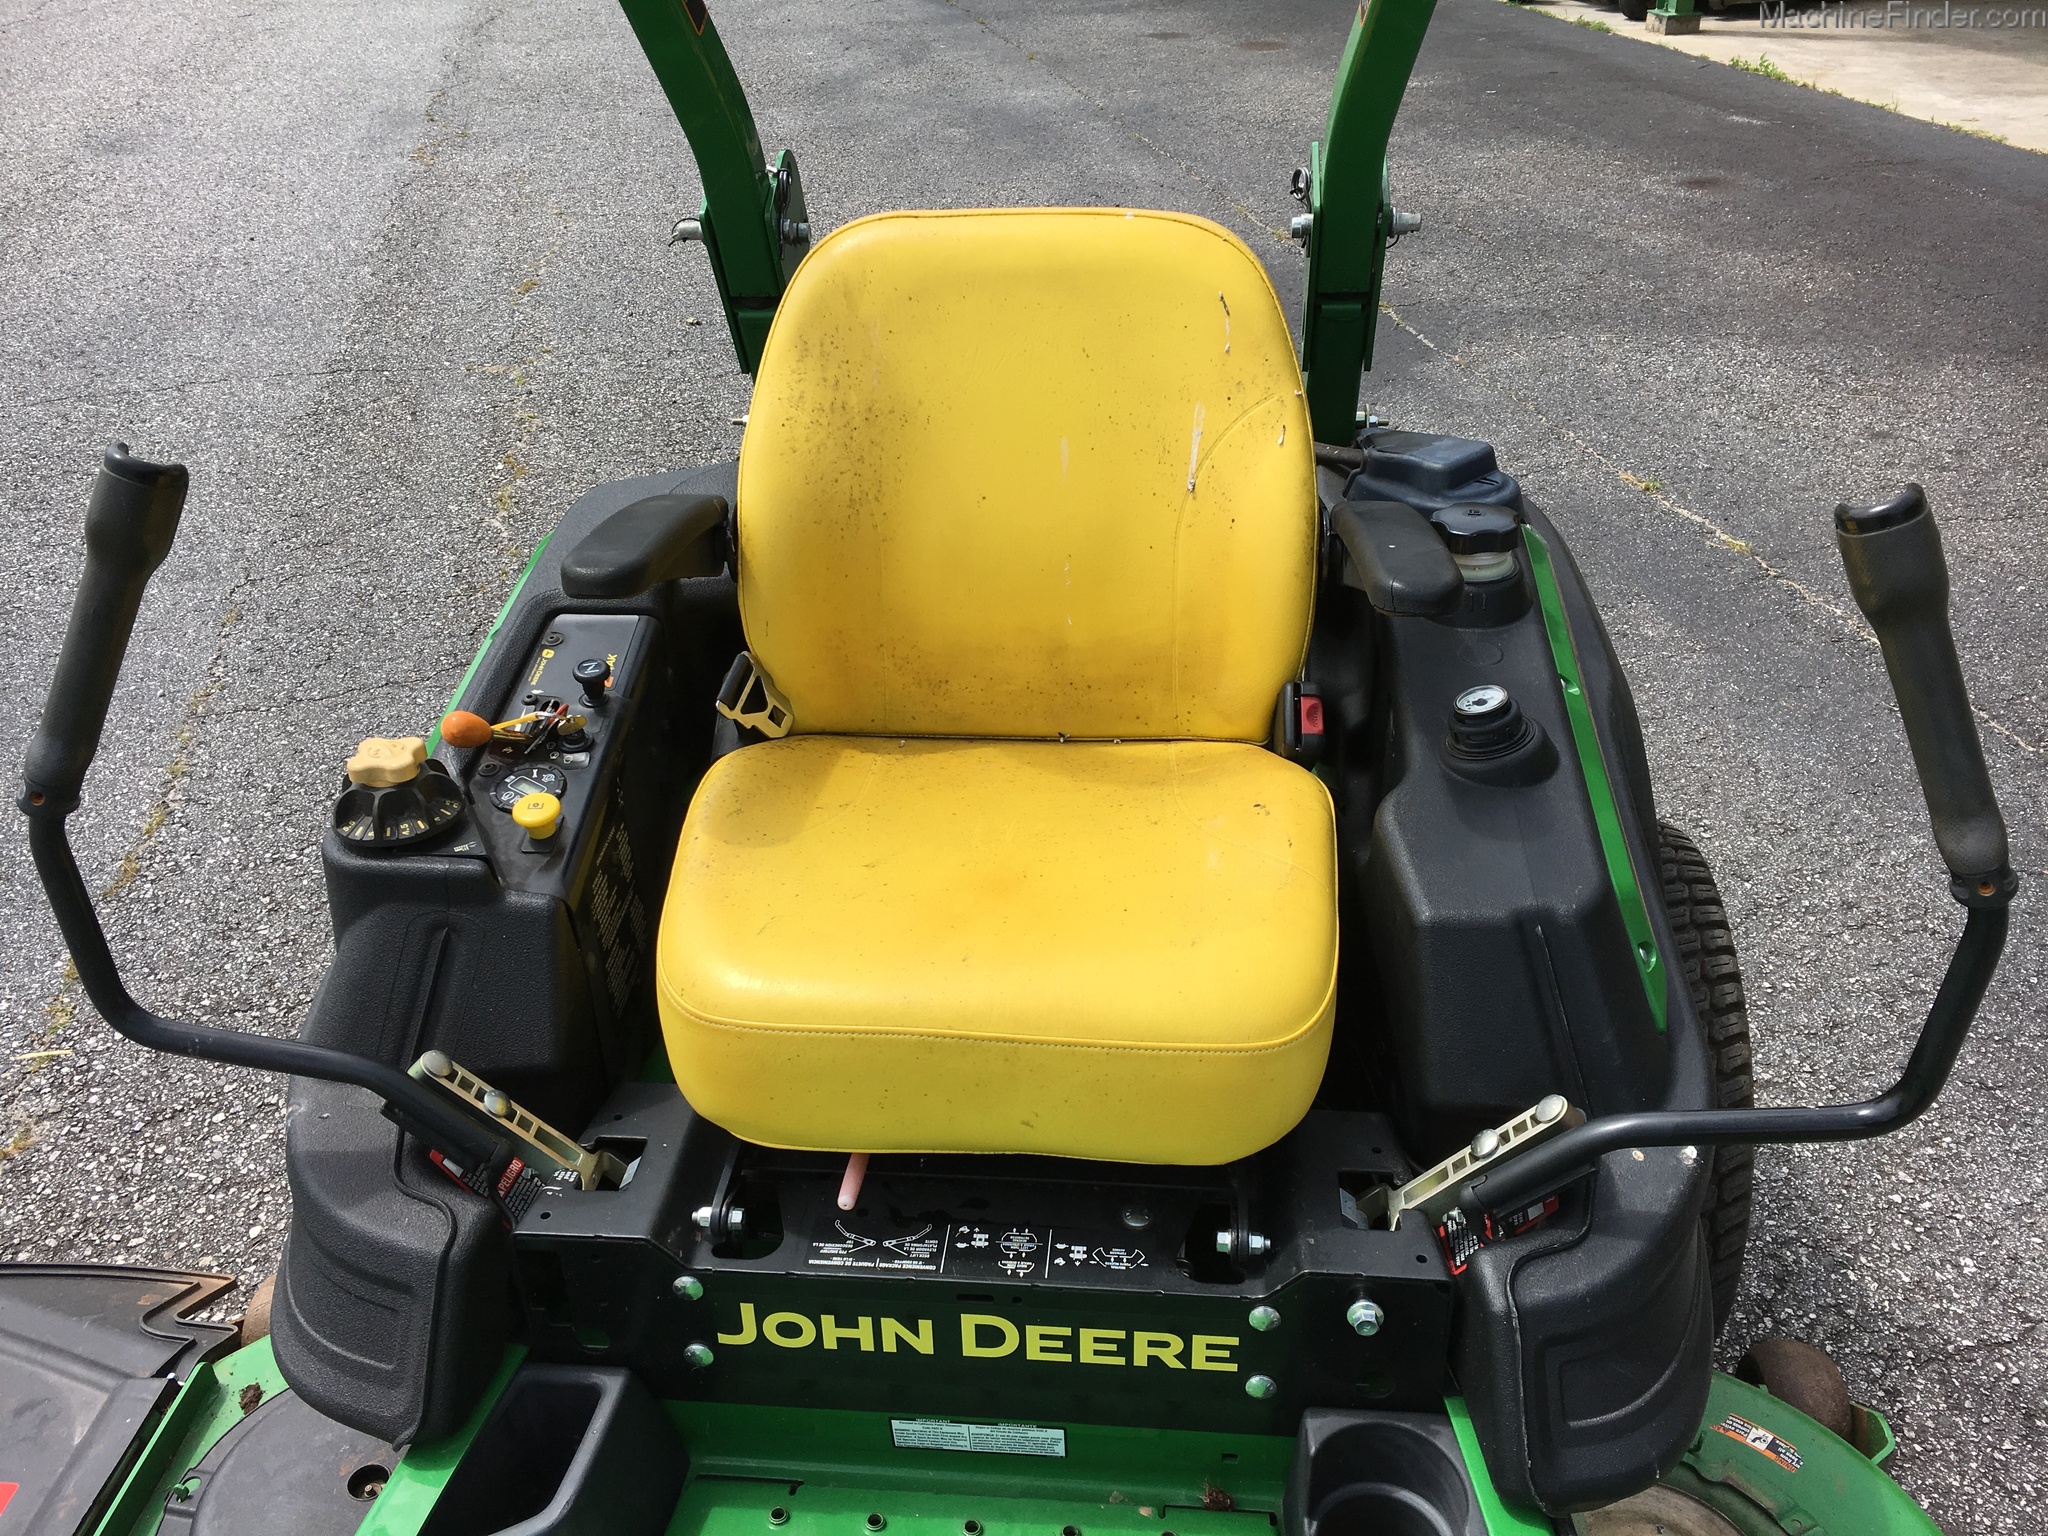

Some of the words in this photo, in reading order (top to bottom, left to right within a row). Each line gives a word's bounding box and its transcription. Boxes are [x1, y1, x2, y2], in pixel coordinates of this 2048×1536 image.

[400, 823, 411, 836] 4.5
[499, 1159, 522, 1192] PELIGRO
[717, 1302, 934, 1355] JOHN
[960, 1313, 1240, 1372] DEERE
